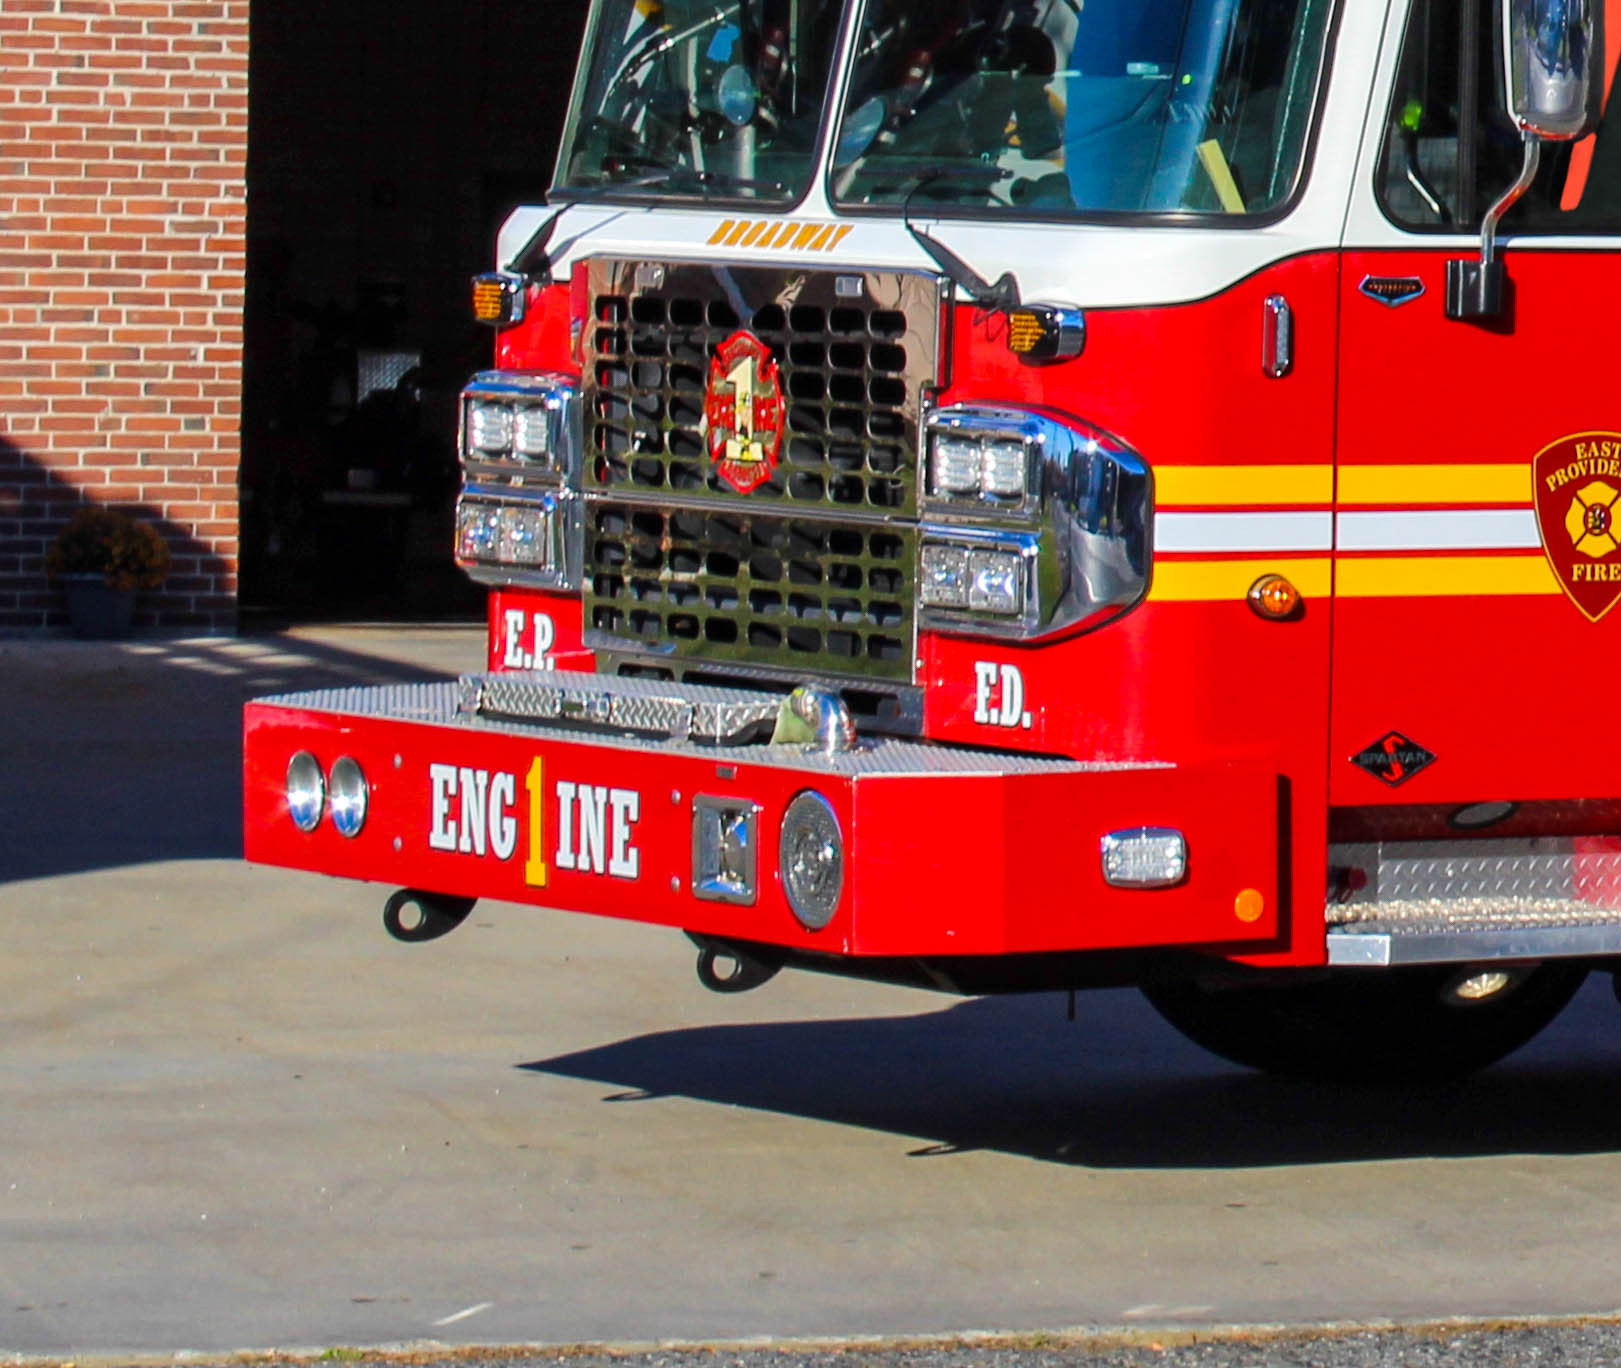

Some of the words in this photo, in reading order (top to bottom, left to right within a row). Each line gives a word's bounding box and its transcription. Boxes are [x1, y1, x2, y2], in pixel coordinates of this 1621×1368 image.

[706, 220, 855, 252] BROADWAY
[1571, 563, 1621, 582] FIRE
[504, 610, 555, 671] E.P.
[973, 661, 1032, 729] F.D.
